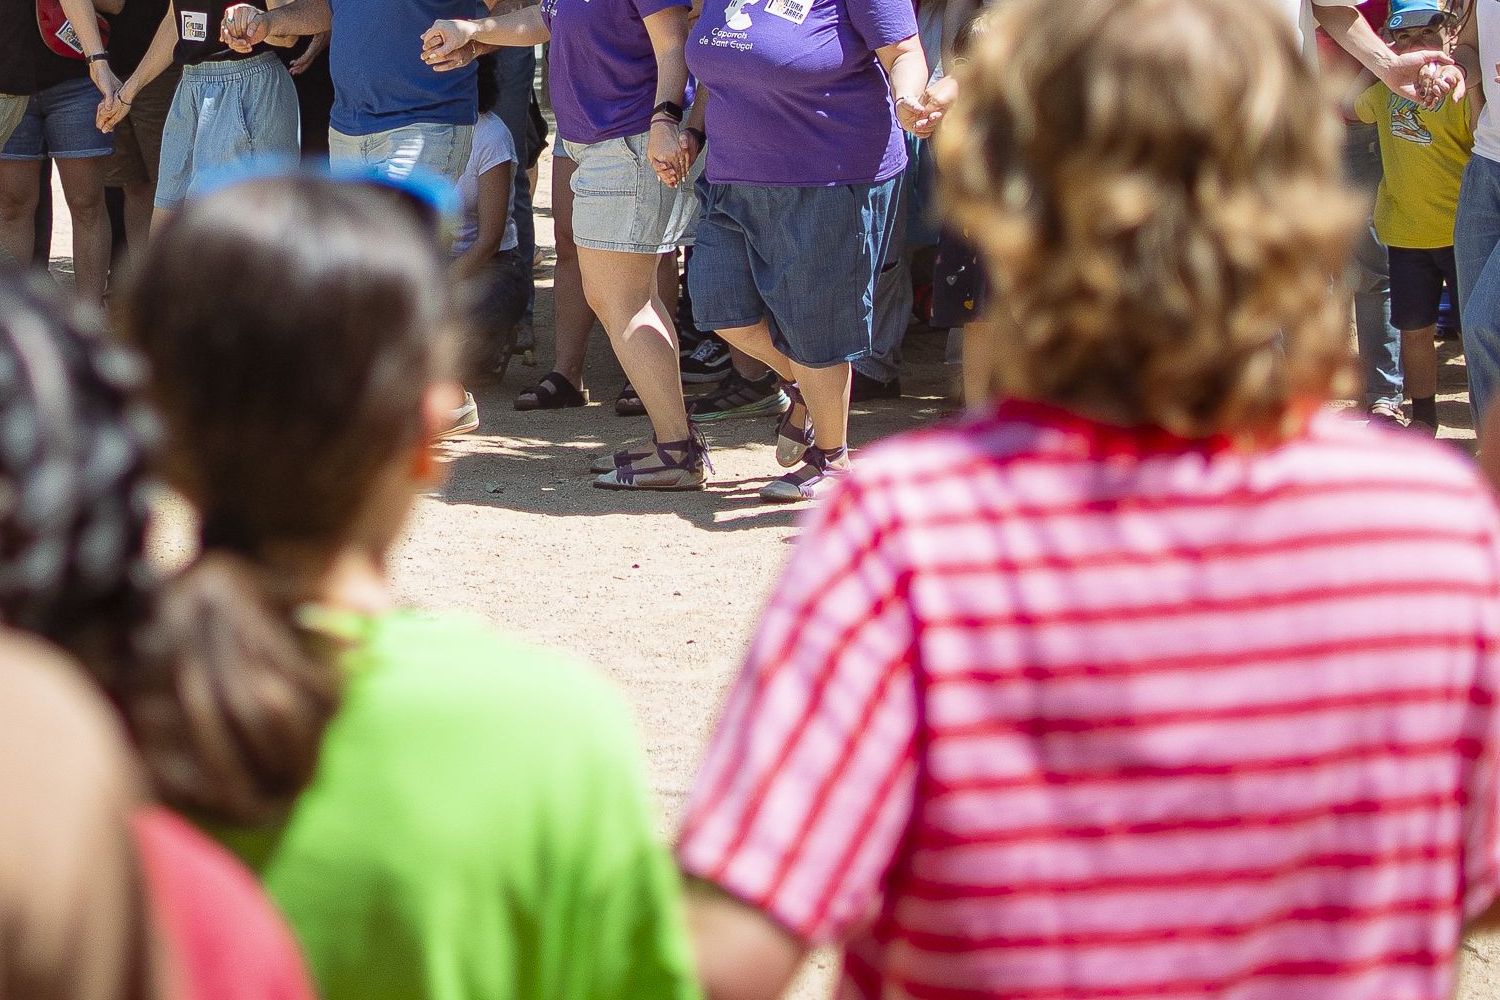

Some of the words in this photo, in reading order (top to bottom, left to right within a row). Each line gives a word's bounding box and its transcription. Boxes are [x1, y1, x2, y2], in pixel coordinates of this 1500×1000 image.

[711, 27, 748, 40] Caparrots
[698, 35, 709, 45] de
[711, 37, 729, 48] Sant
